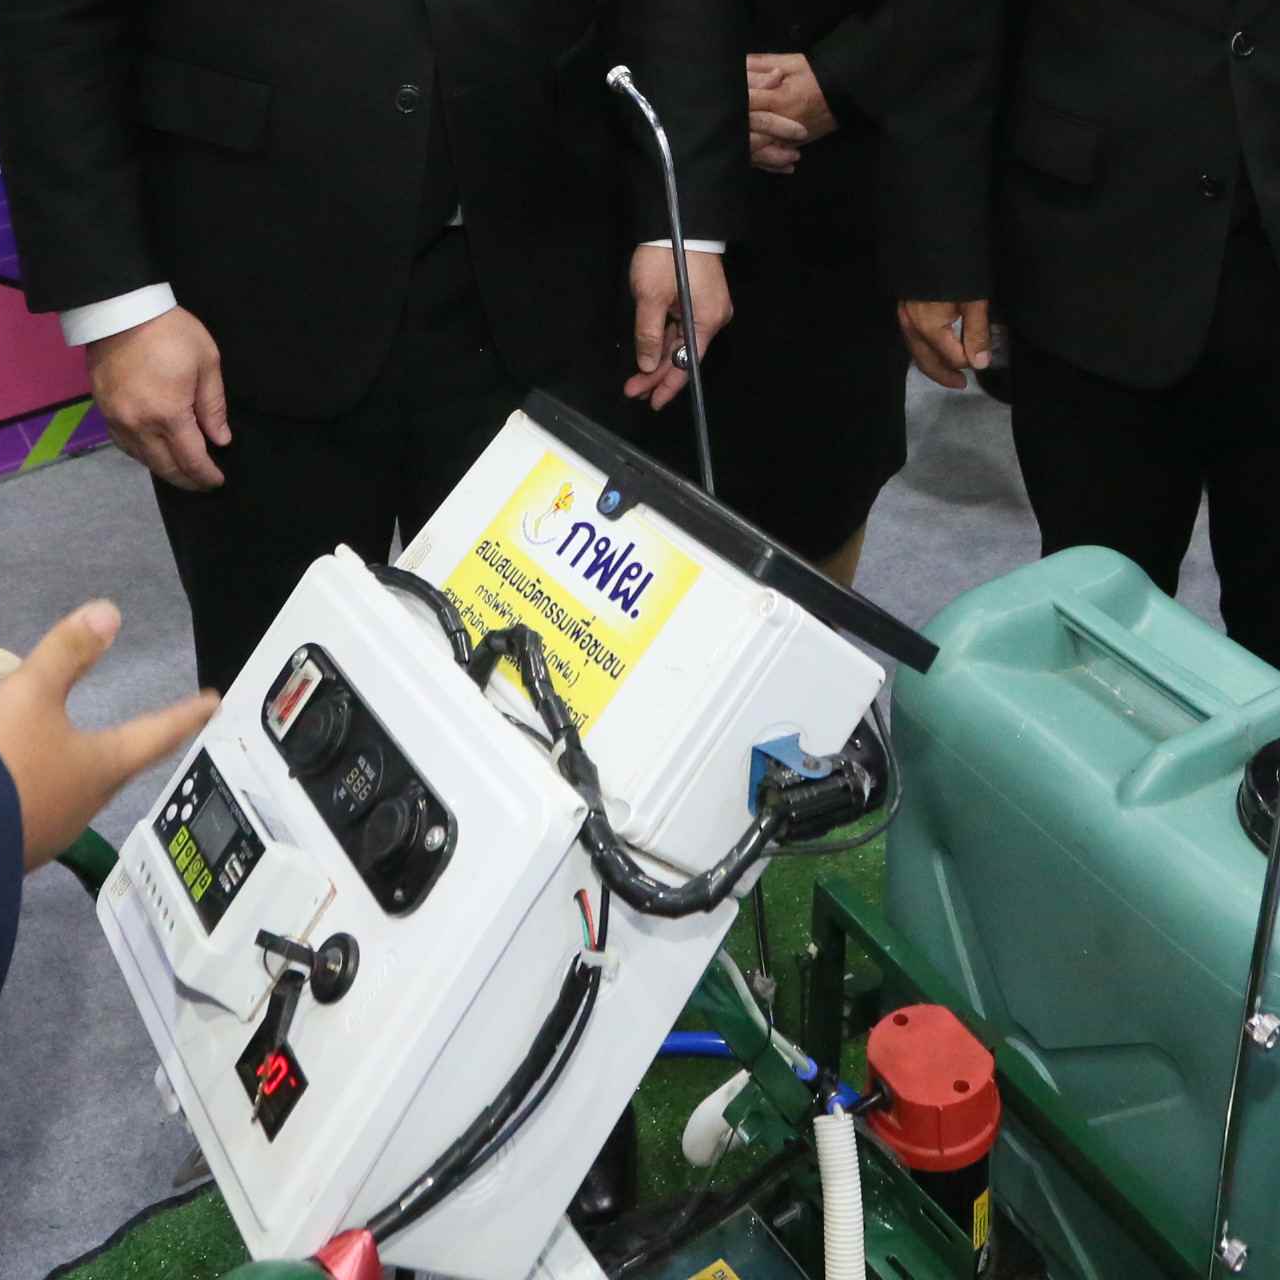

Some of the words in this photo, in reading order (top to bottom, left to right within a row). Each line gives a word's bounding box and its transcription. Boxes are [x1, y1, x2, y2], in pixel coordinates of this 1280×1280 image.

[475, 539, 626, 680] สนับสนุนนวัตกรรมเพื่อชุมชน
[556, 521, 655, 619] กฟผ.
